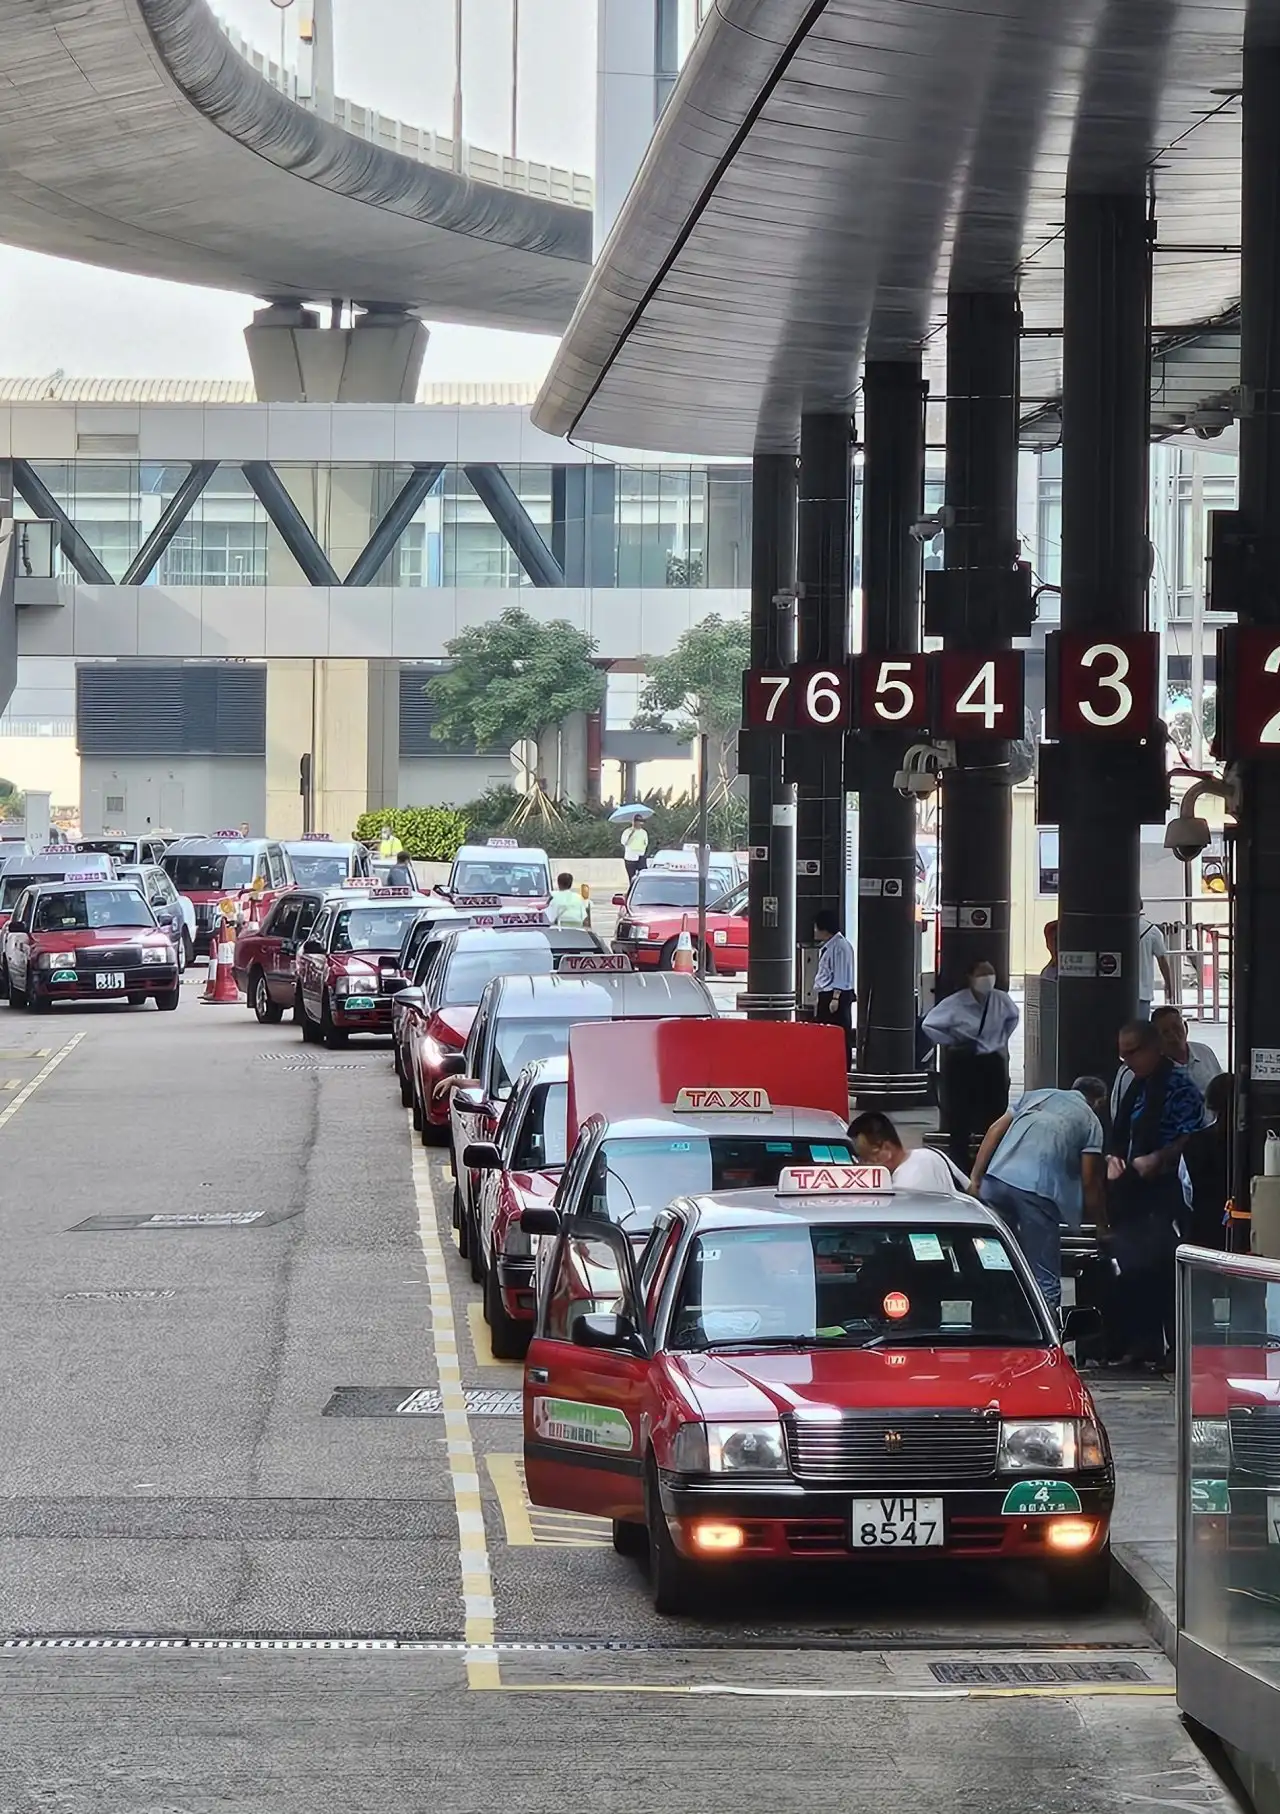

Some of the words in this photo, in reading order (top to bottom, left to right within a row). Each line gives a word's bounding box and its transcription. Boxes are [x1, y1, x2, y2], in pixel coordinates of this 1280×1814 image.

[873, 662, 914, 719] 5
[955, 661, 1004, 728] 4
[1078, 643, 1133, 725] 3
[760, 676, 790, 722] 7
[806, 671, 841, 723] 6
[459, 895, 498, 905] TAXI
[472, 915, 494, 925] TA
[566, 956, 624, 968] TAXI
[686, 1090, 762, 1107] TAXI
[791, 1168, 882, 1189] TAXI
[1034, 1486, 1050, 1502] 4
[880, 1498, 918, 1522] VH
[860, 1522, 937, 1545] 8547
